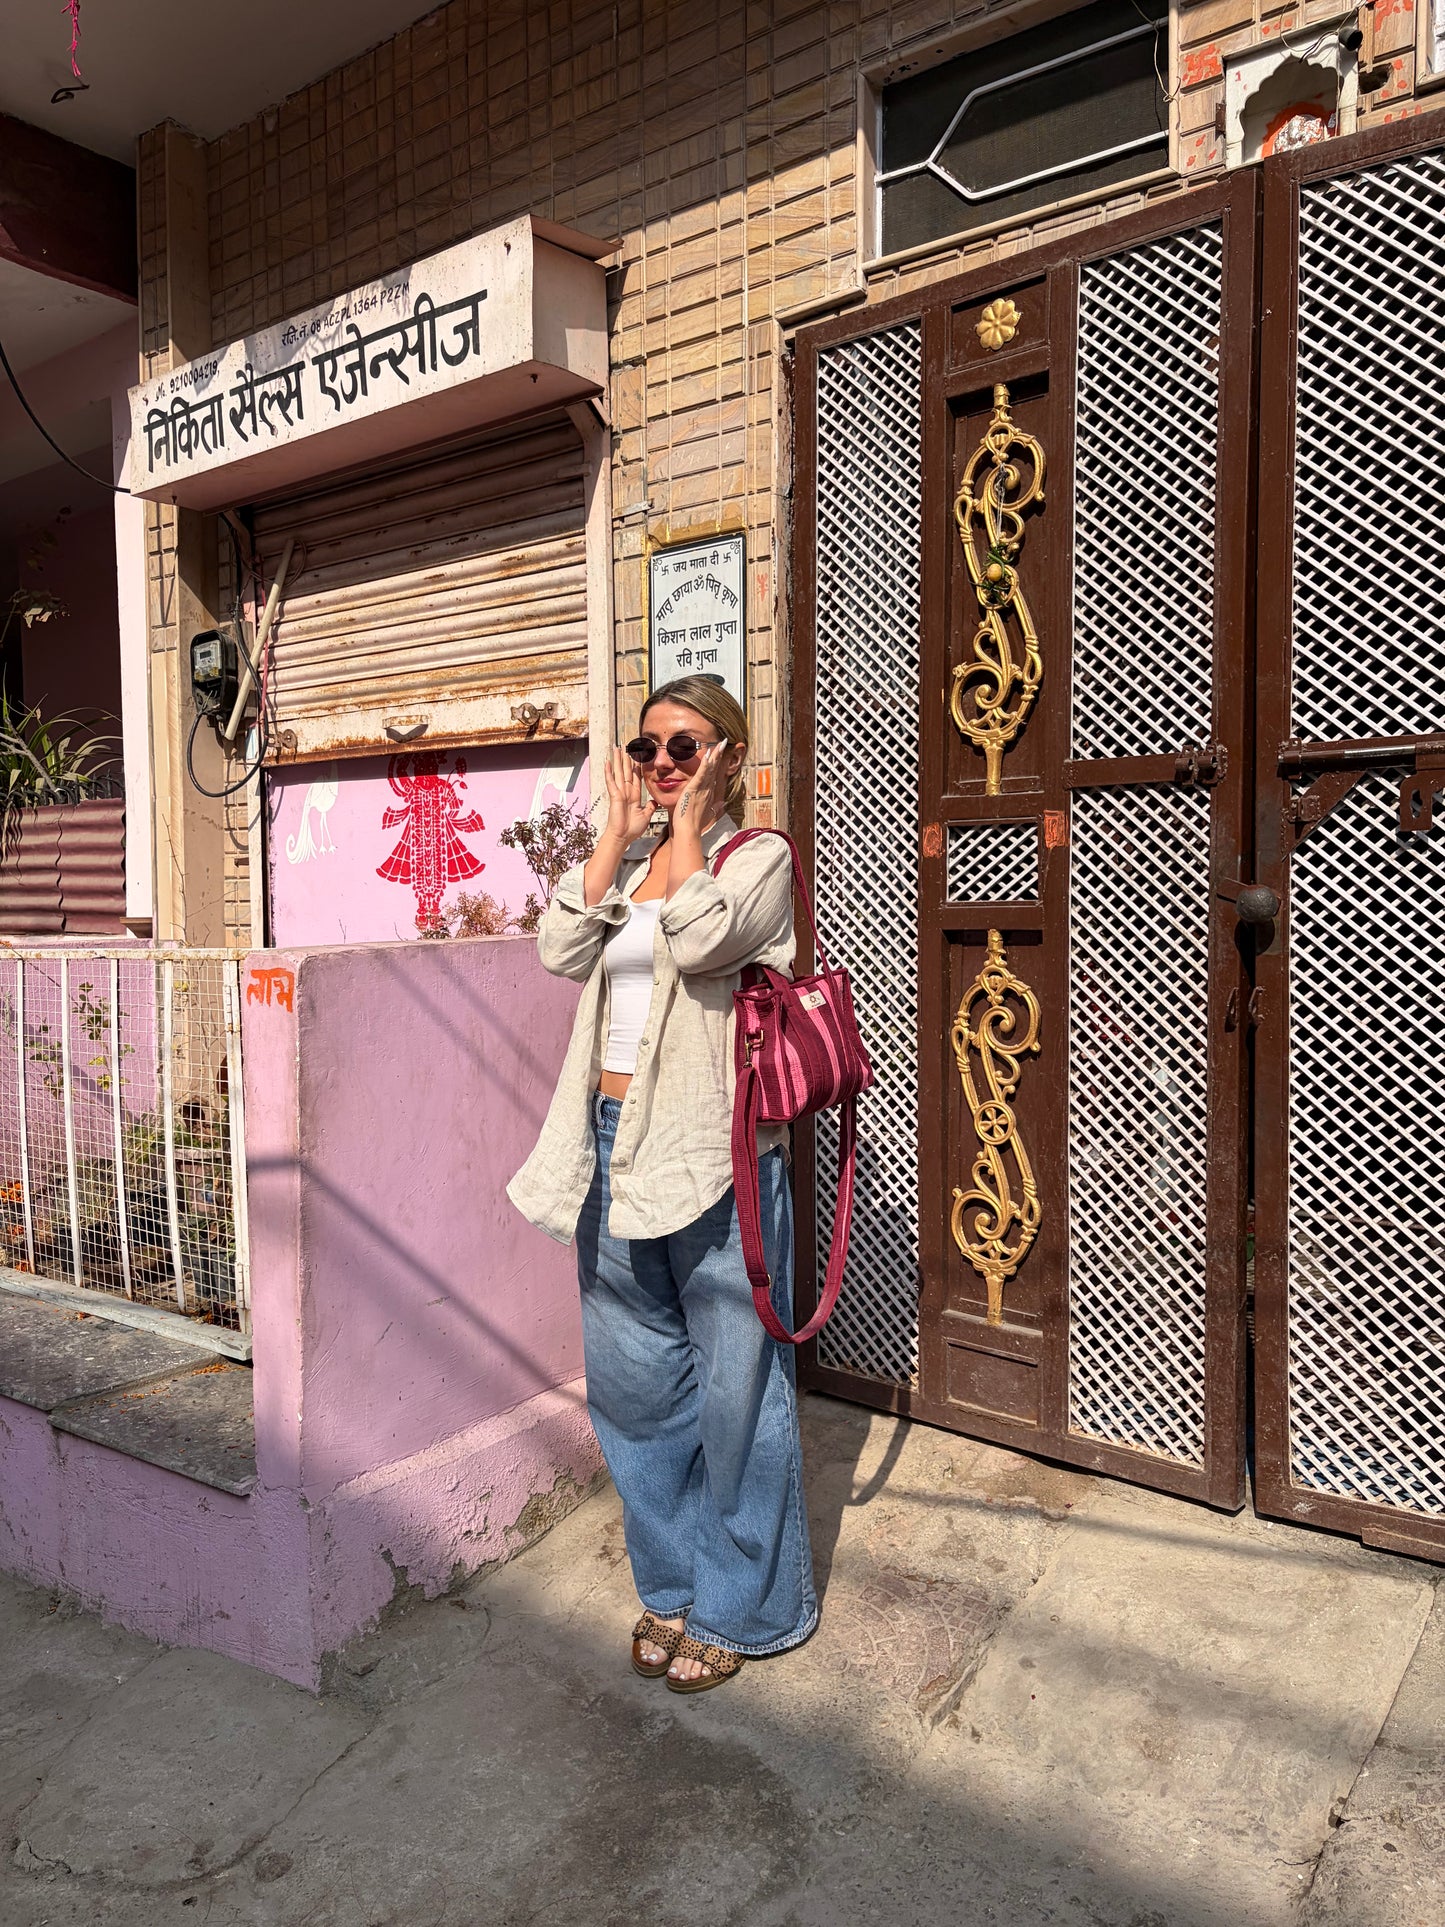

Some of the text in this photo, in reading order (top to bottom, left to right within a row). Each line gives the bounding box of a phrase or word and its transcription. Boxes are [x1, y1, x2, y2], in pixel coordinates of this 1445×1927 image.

[143, 393, 224, 473] निकिता
[311, 288, 488, 412] एजेन्सीज
[672, 550, 720, 574] जय माता दी
[655, 597, 674, 622] मातृ
[671, 580, 693, 602] छाया
[705, 573, 722, 600] पितृ
[721, 585, 739, 609] कृपा
[657, 620, 738, 647] किशन लाल गुप्ता
[675, 647, 718, 671] रवि गुप्ता
